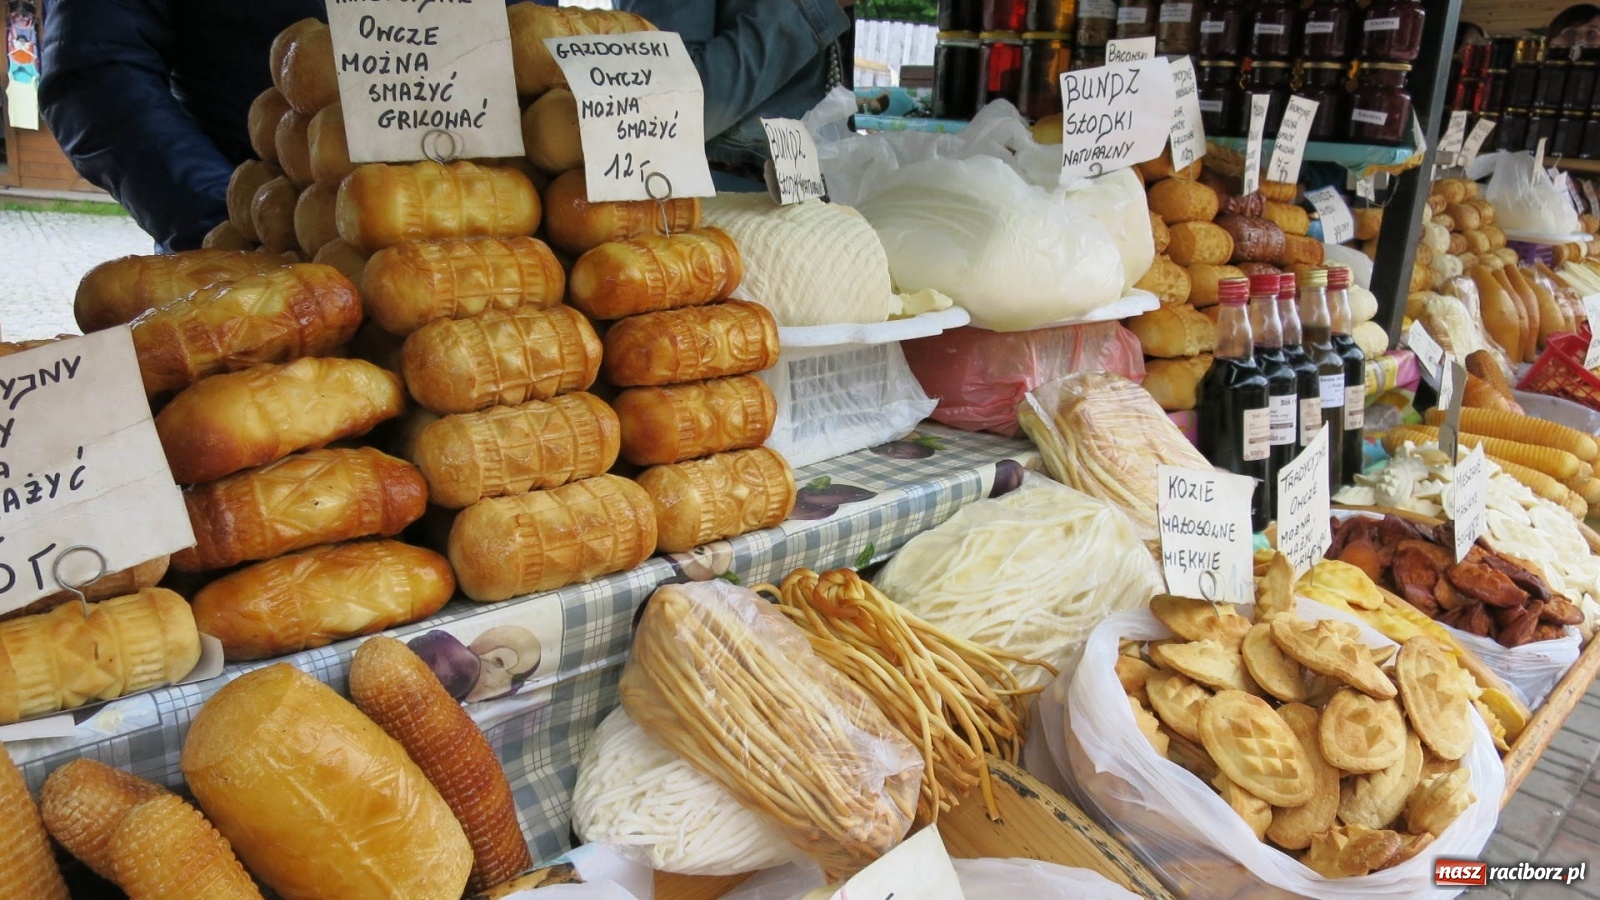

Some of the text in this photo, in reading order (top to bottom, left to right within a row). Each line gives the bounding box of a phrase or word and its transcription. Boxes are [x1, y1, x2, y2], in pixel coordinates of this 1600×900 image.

[359, 15, 440, 45] OWCZE
[341, 50, 429, 75] MOŻNA
[556, 42, 670, 59] GAZDOWSKI
[368, 71, 458, 103] SMAŻYĆ
[589, 66, 652, 86] OWCZY
[1064, 68, 1141, 110] BUNDZ
[377, 98, 488, 131] GRILOWAĆ
[581, 95, 640, 119] MOŻNA
[616, 110, 679, 141] SMAŻYĆ
[1065, 110, 1133, 144] SŁODKI
[764, 122, 806, 169] BUNDZ
[1062, 141, 1136, 167] NATURALNY
[1168, 475, 1215, 503] KOZIE
[1161, 514, 1236, 542] MAŁOSOLNE
[1164, 549, 1221, 574] MIĘKKIE
